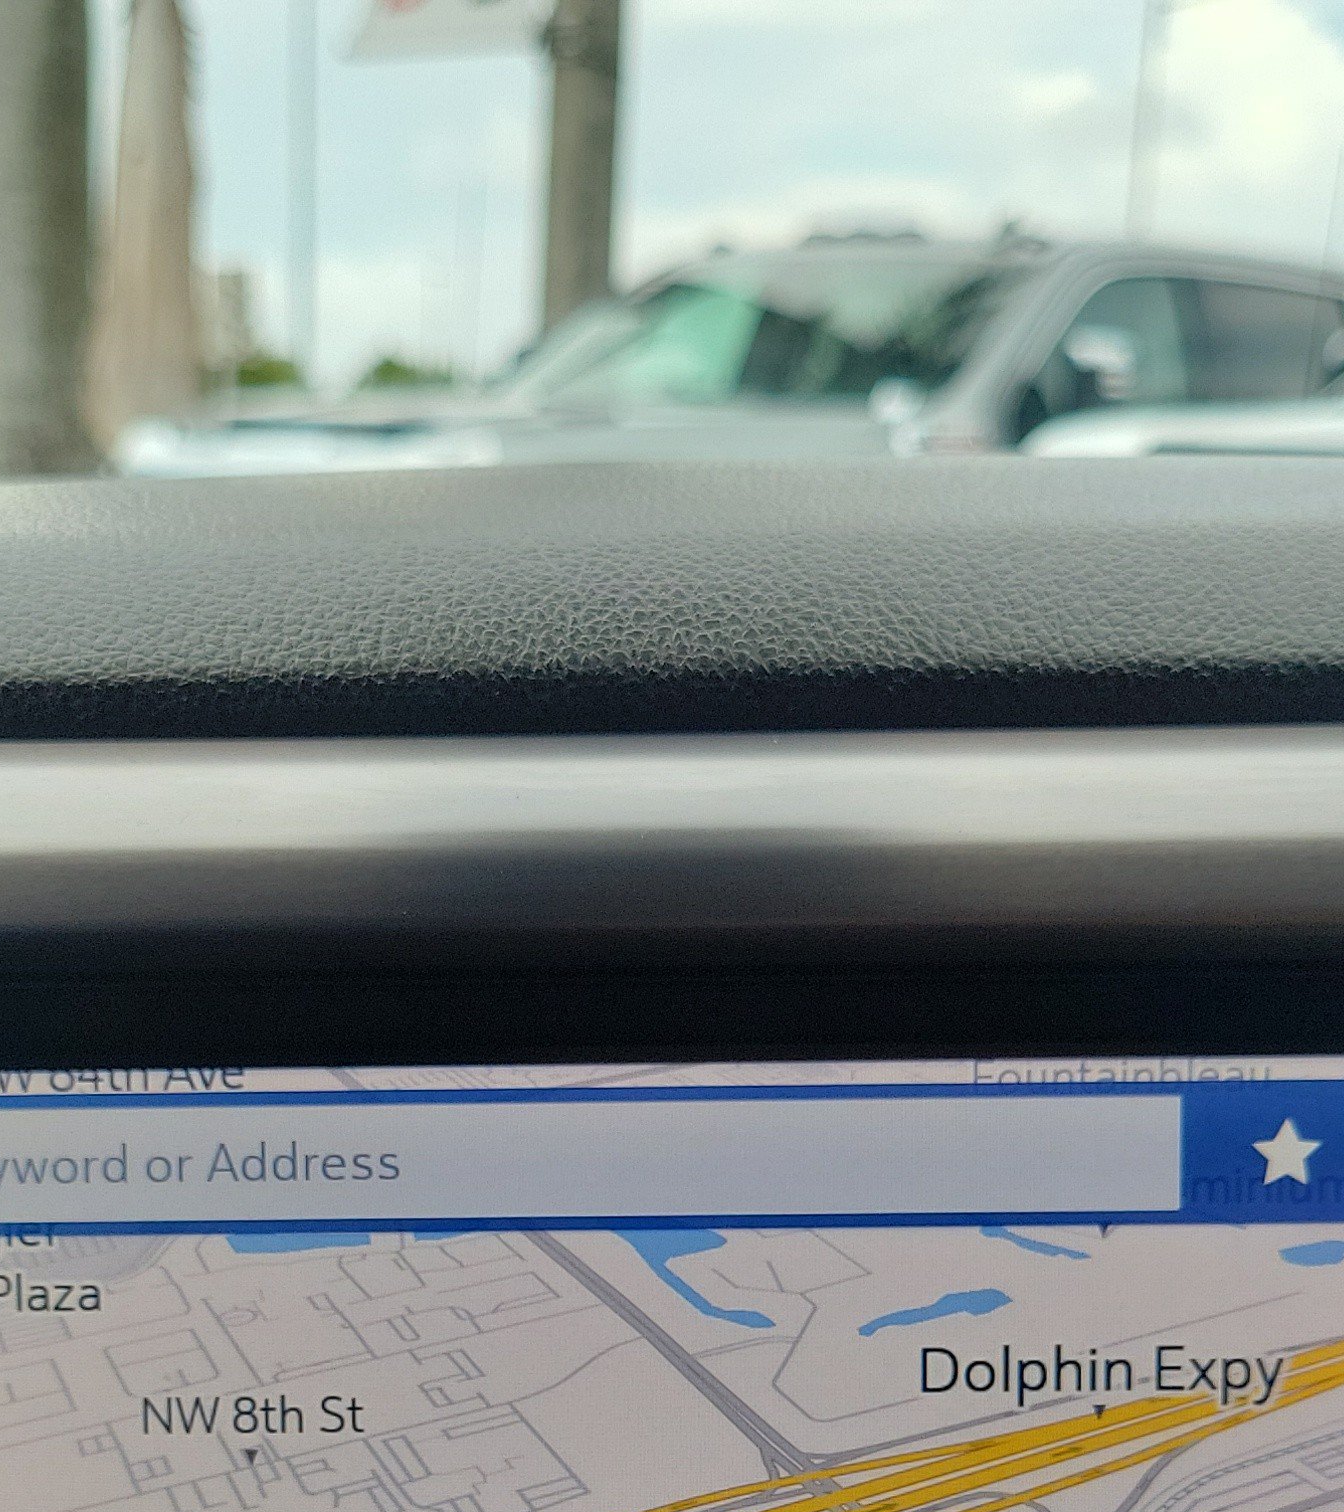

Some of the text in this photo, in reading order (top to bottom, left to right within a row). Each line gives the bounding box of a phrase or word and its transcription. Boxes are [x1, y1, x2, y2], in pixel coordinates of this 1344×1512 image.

[164, 1066, 244, 1090] Ave
[146, 1154, 192, 1183] or
[207, 1141, 400, 1181] Address
[920, 1346, 1285, 1406] Dolphin Expy
[142, 1395, 365, 1435] NW 8th St
